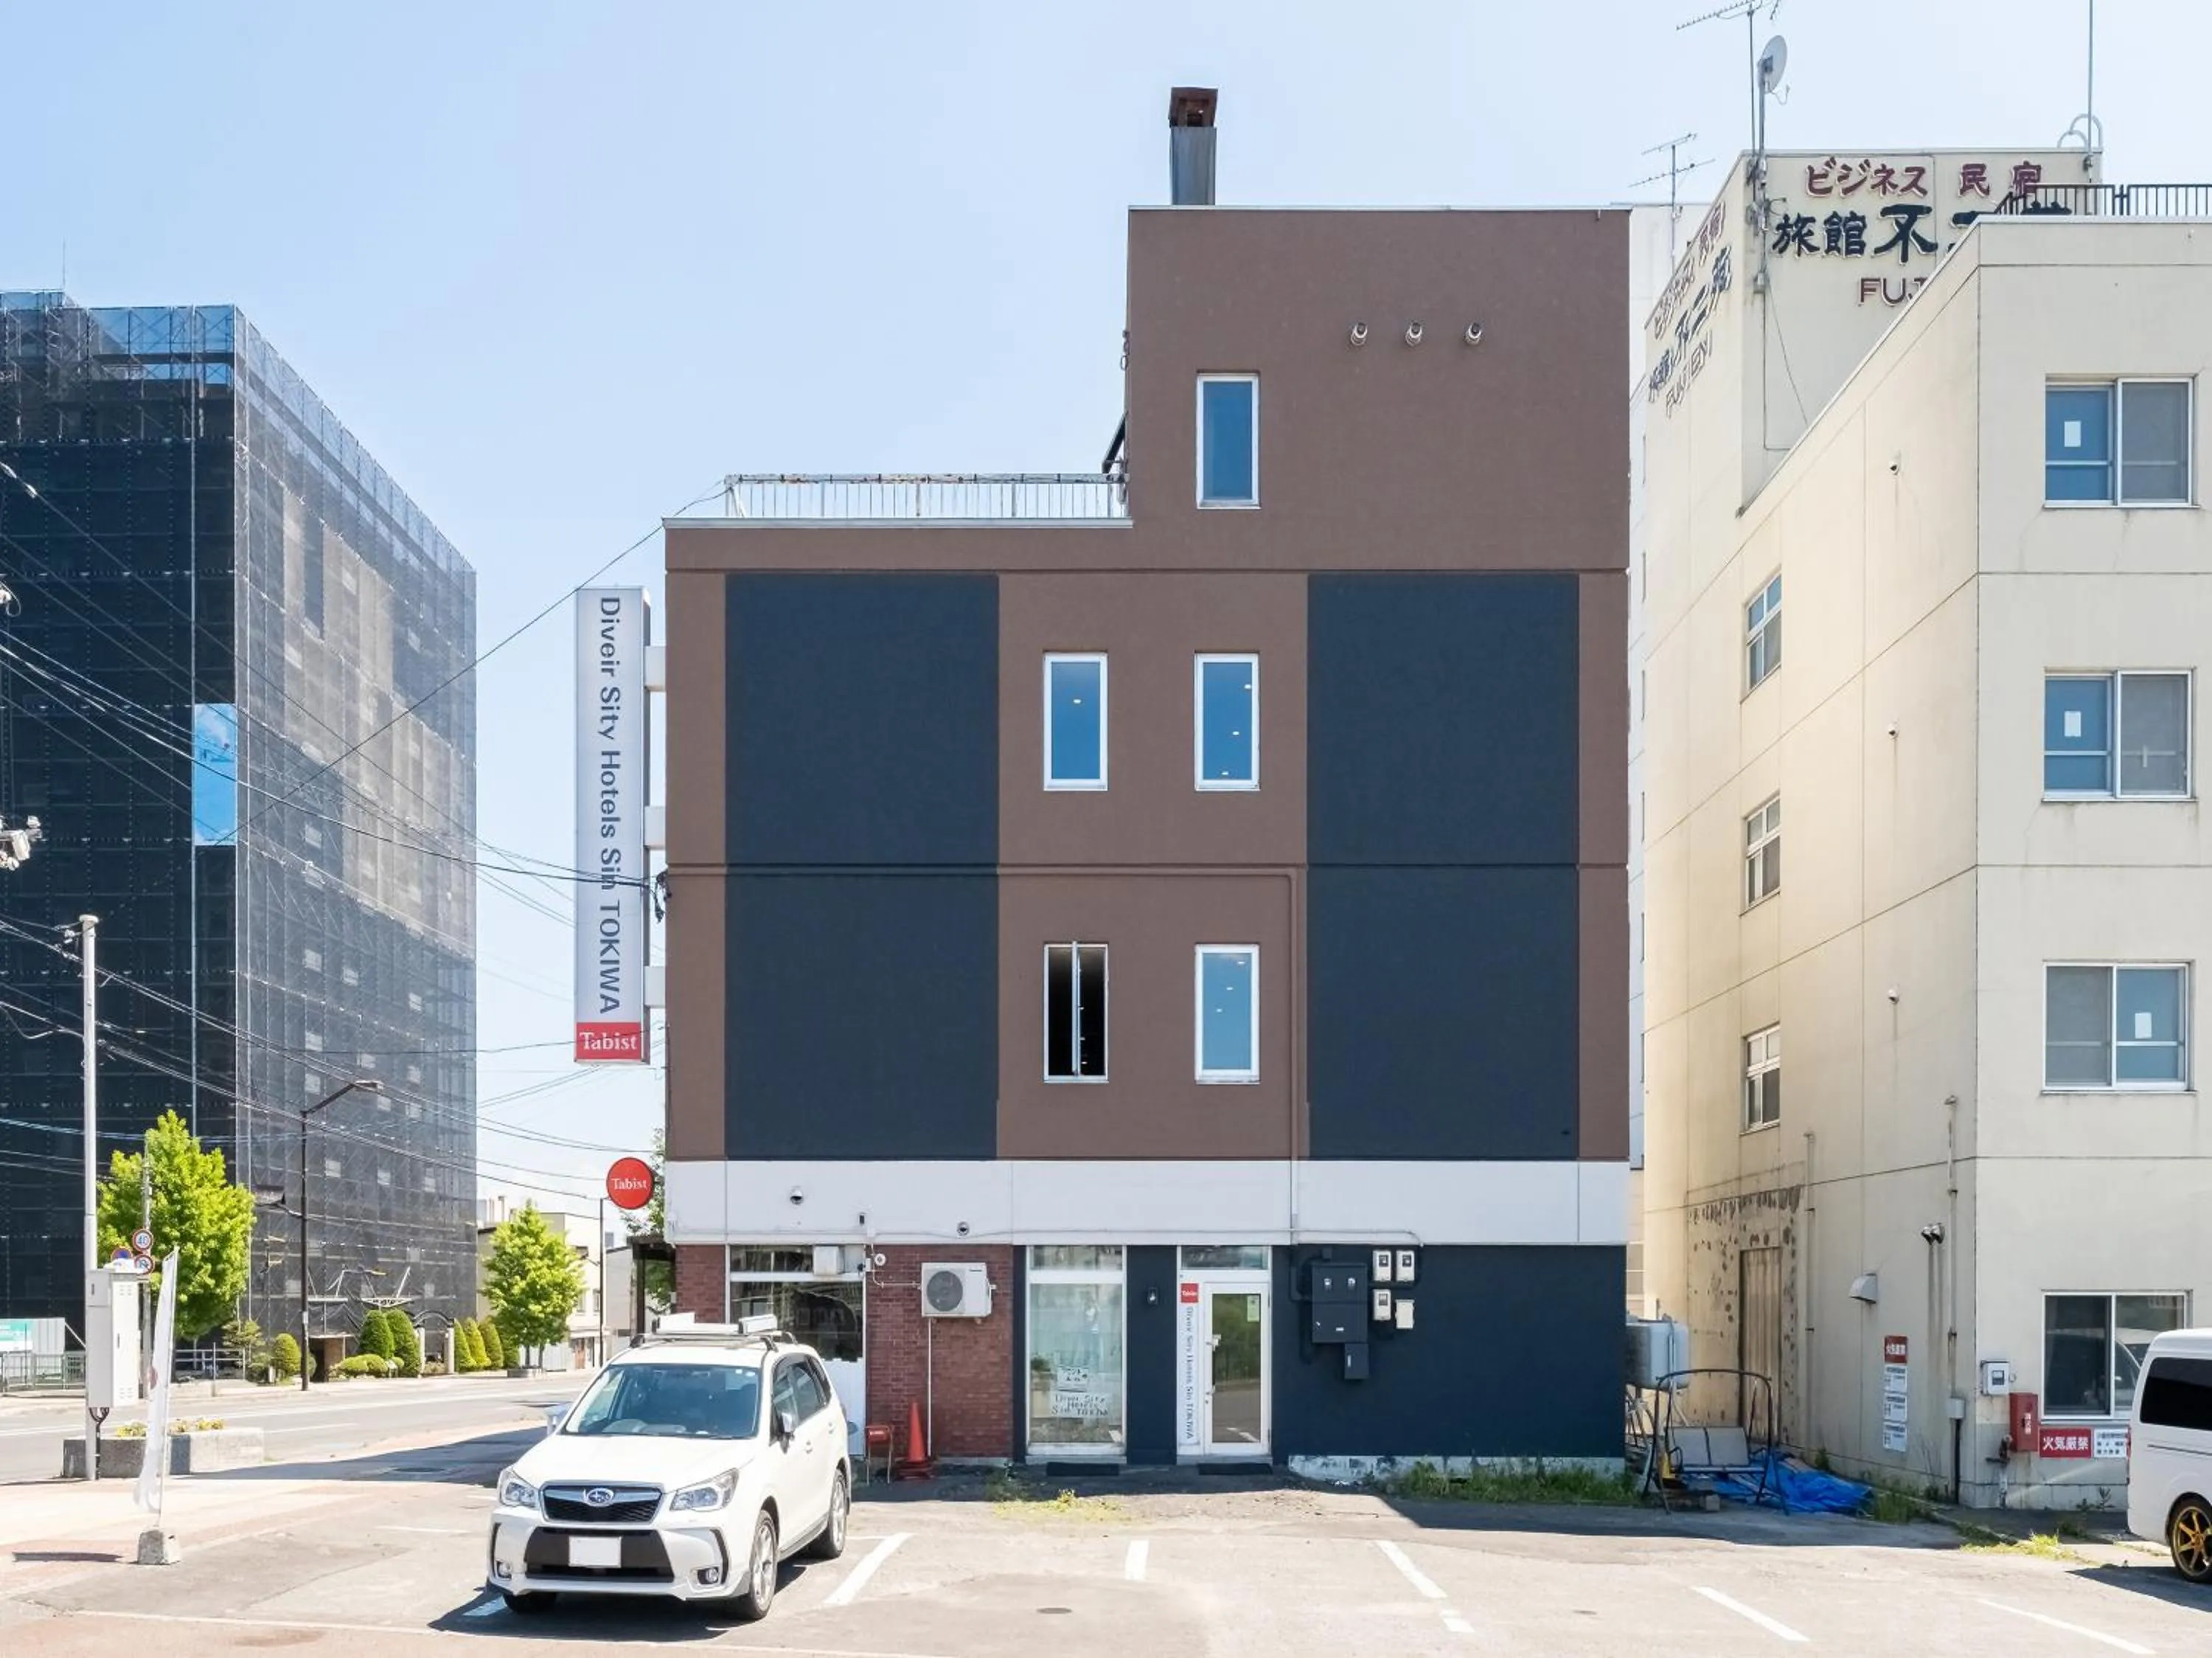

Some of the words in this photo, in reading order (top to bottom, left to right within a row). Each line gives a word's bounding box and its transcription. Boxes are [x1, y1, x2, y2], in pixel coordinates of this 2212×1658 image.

[1806, 156, 1928, 198] ビジネス
[599, 597, 621, 677] Diveir
[597, 687, 621, 740] Sity
[599, 751, 622, 839] Hotels
[600, 848, 622, 890] Sin
[599, 900, 621, 1015] TOKIWA
[579, 1032, 638, 1050] Tabist
[611, 1178, 647, 1190] Tabist
[2042, 1436, 2089, 1451] 火気厳禁
